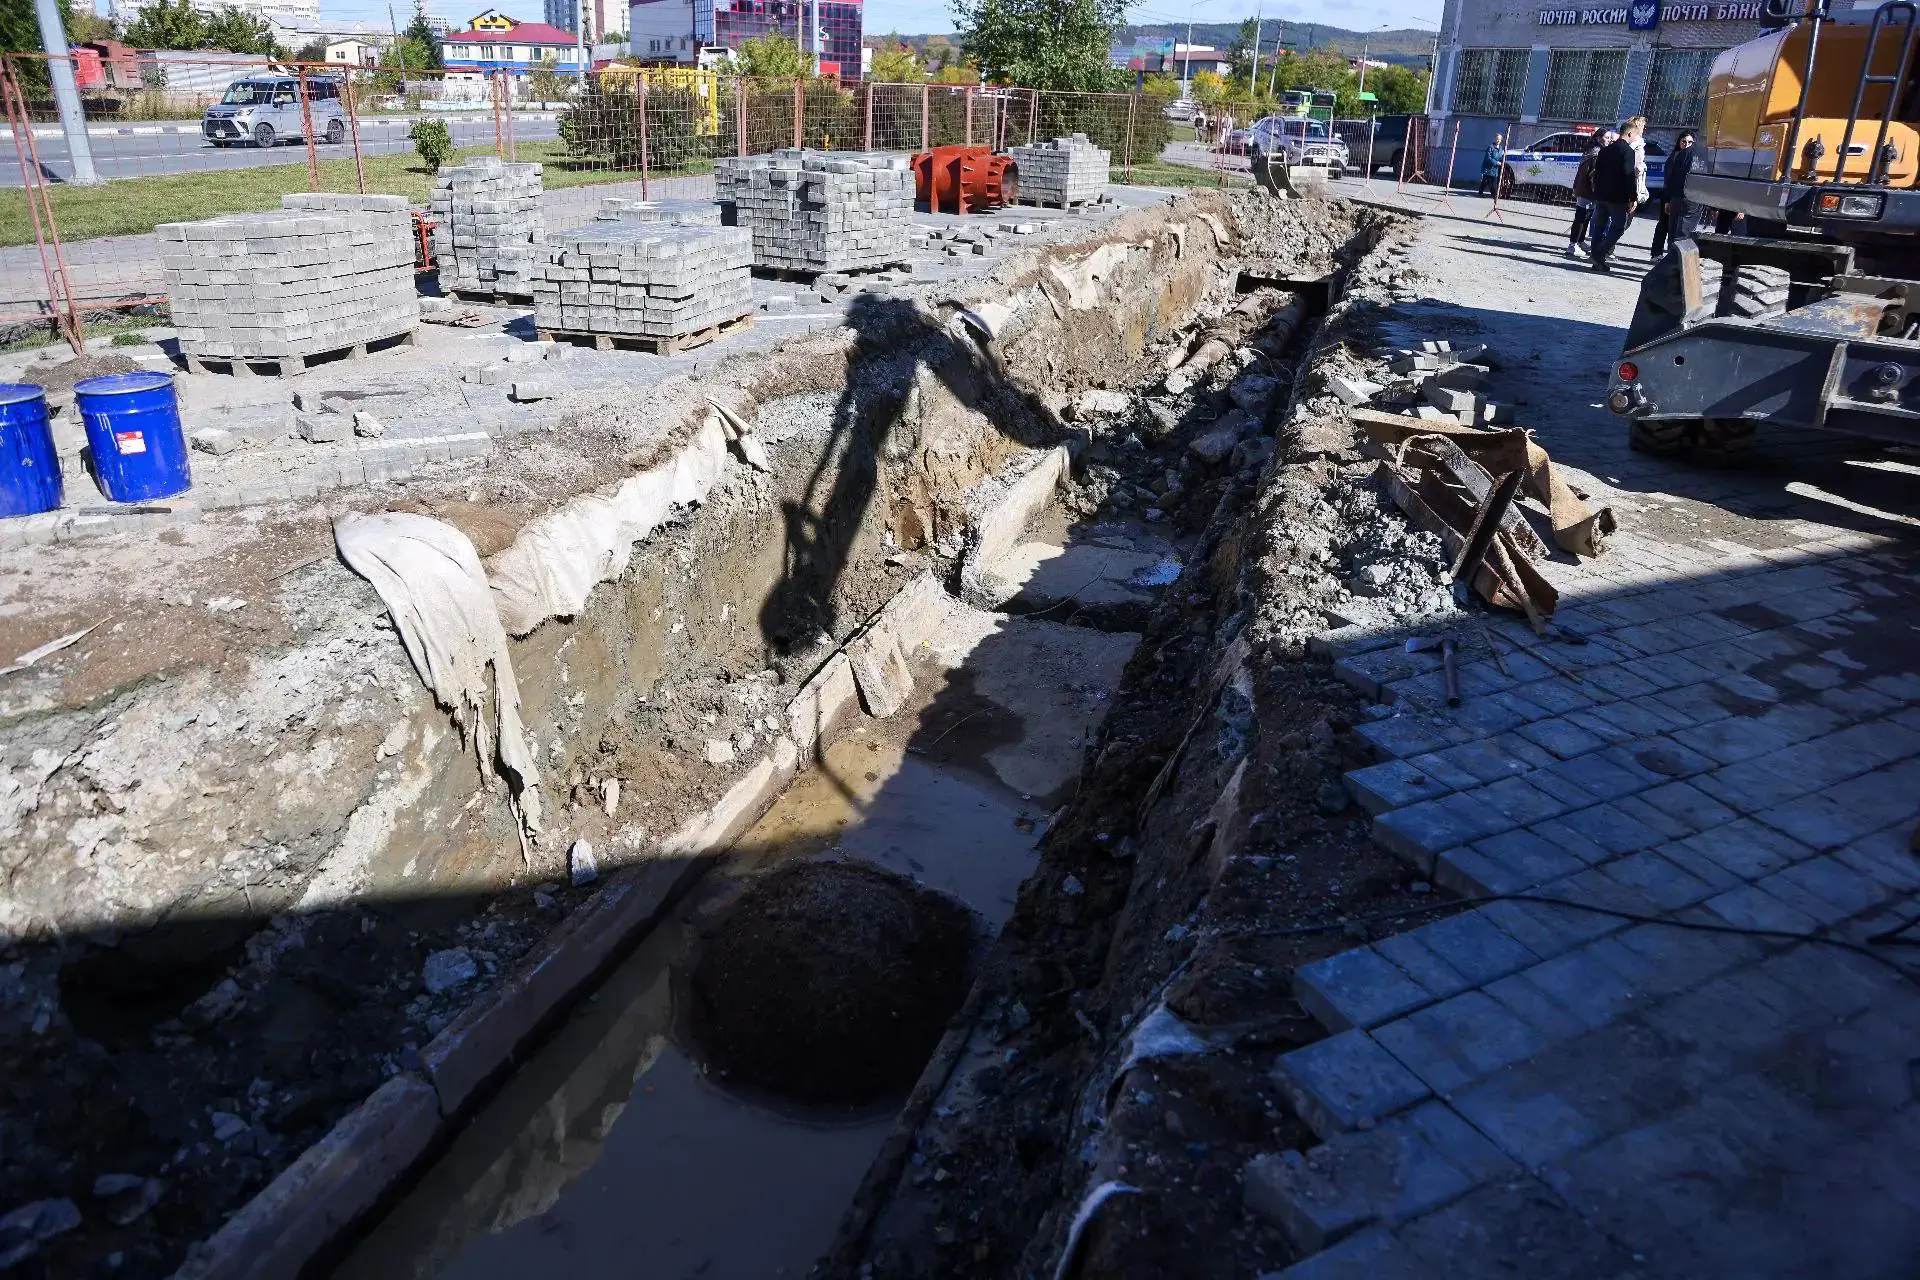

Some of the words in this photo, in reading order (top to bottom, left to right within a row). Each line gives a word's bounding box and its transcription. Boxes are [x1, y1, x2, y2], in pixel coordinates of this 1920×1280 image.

[1539, 10, 1577, 25] ПОЧТА
[1581, 8, 1628, 24] РОССИИ
[1661, 5, 1709, 21] ПОЧТА
[1717, 3, 1762, 20] БАНК
